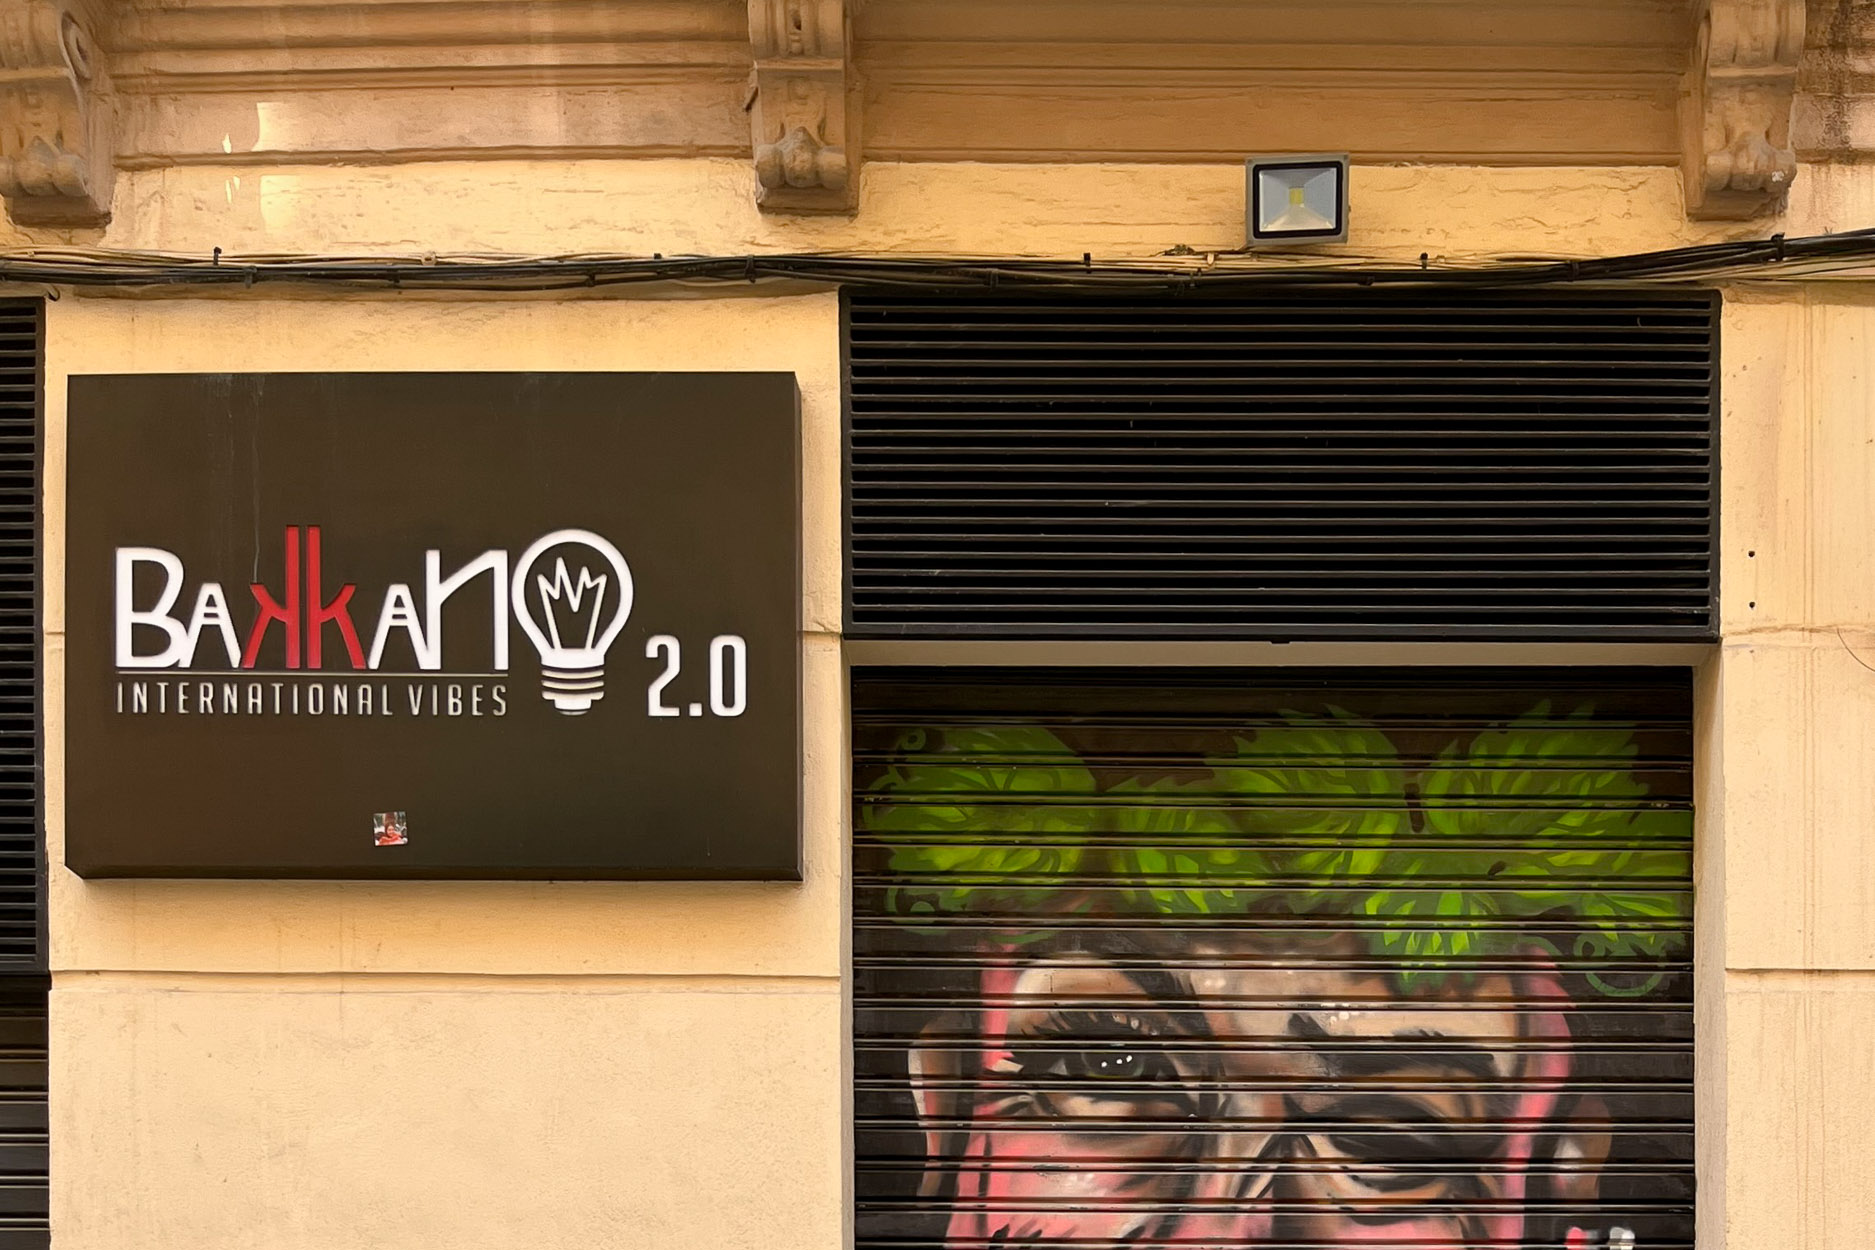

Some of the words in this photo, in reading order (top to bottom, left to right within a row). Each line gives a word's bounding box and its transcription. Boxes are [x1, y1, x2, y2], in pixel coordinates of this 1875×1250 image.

[117, 681, 393, 716] INTERNATIONAL
[408, 683, 507, 716] VIBES
[645, 634, 747, 717] 2.0
